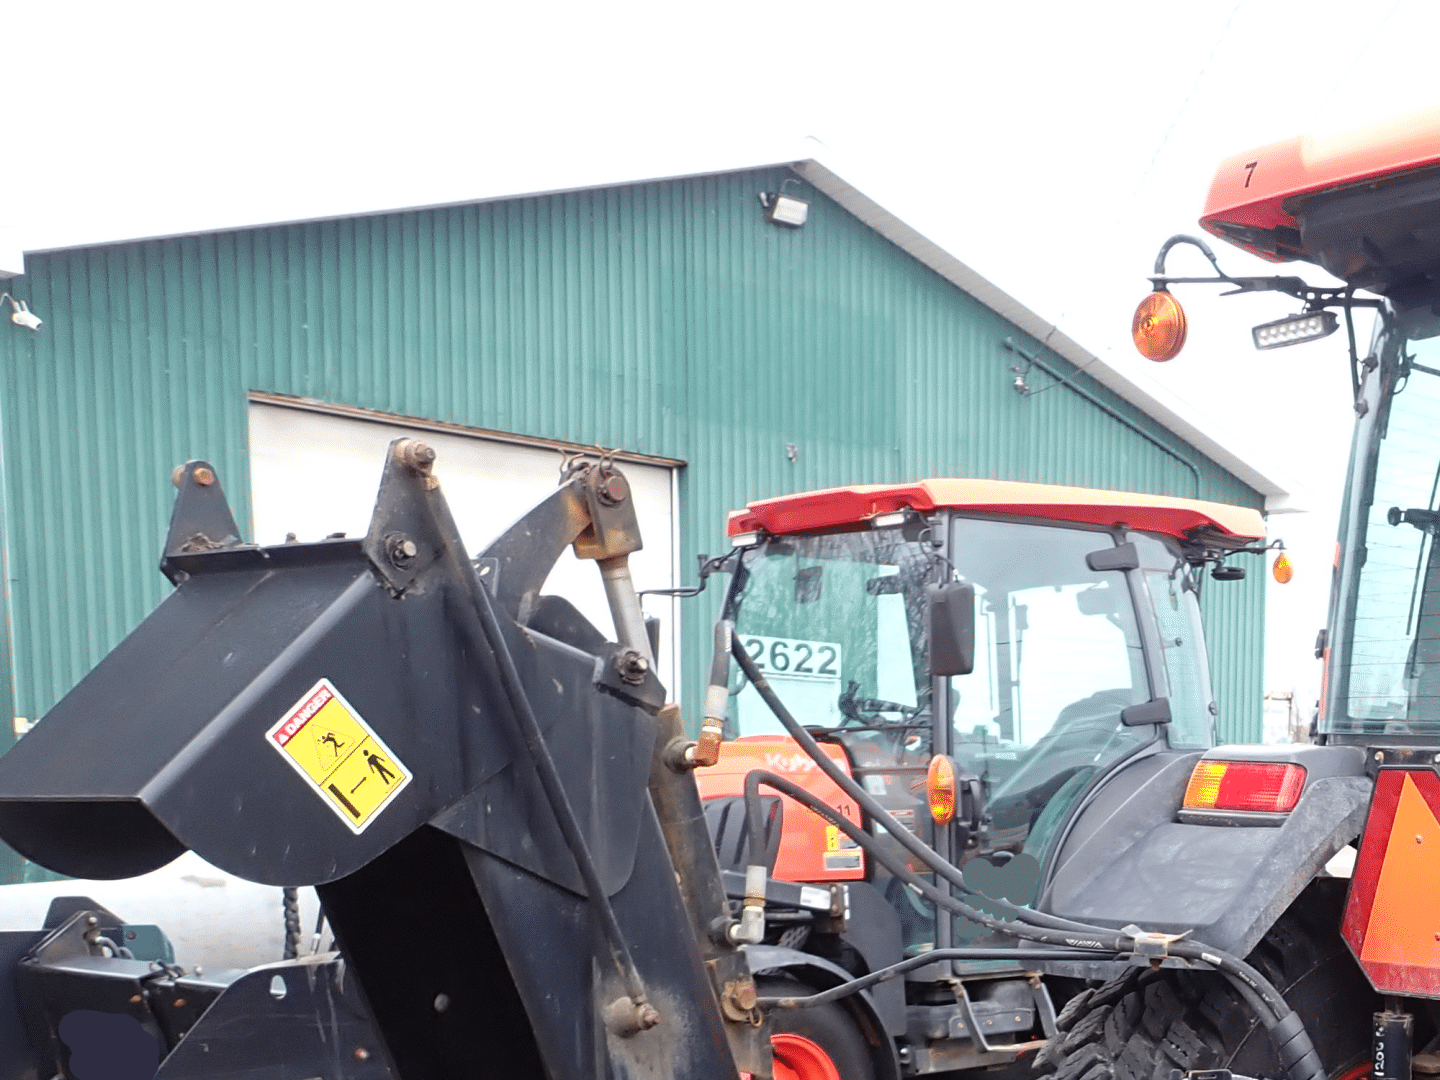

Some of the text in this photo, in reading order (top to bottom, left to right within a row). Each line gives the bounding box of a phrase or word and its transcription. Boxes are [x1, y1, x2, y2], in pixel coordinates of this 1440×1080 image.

[1245, 161, 1257, 188] 7
[745, 638, 837, 676] 2622
[284, 688, 332, 737] DANGER
